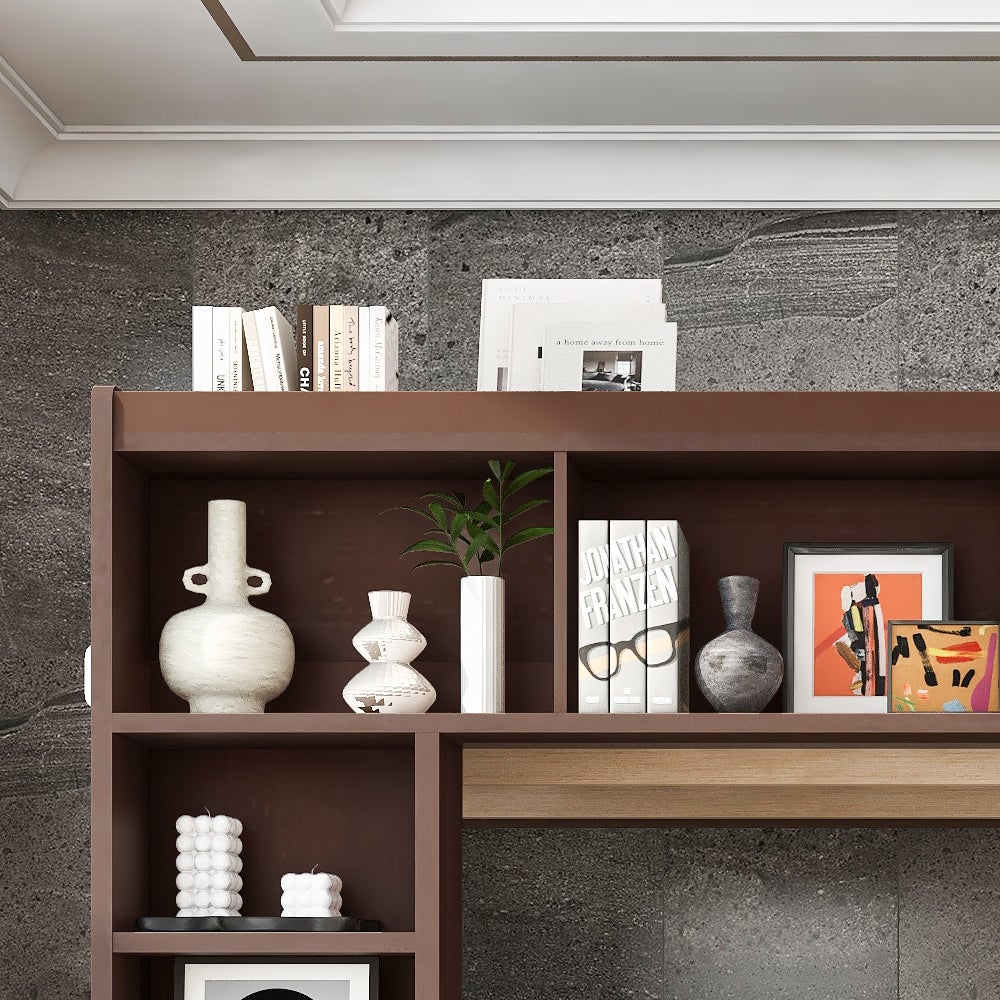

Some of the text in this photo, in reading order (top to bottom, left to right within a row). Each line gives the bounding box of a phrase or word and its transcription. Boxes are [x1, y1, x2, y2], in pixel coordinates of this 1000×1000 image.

[302, 349, 307, 357] OF
[579, 525, 678, 587] JONATHAN
[579, 564, 679, 631] FRANZEN
